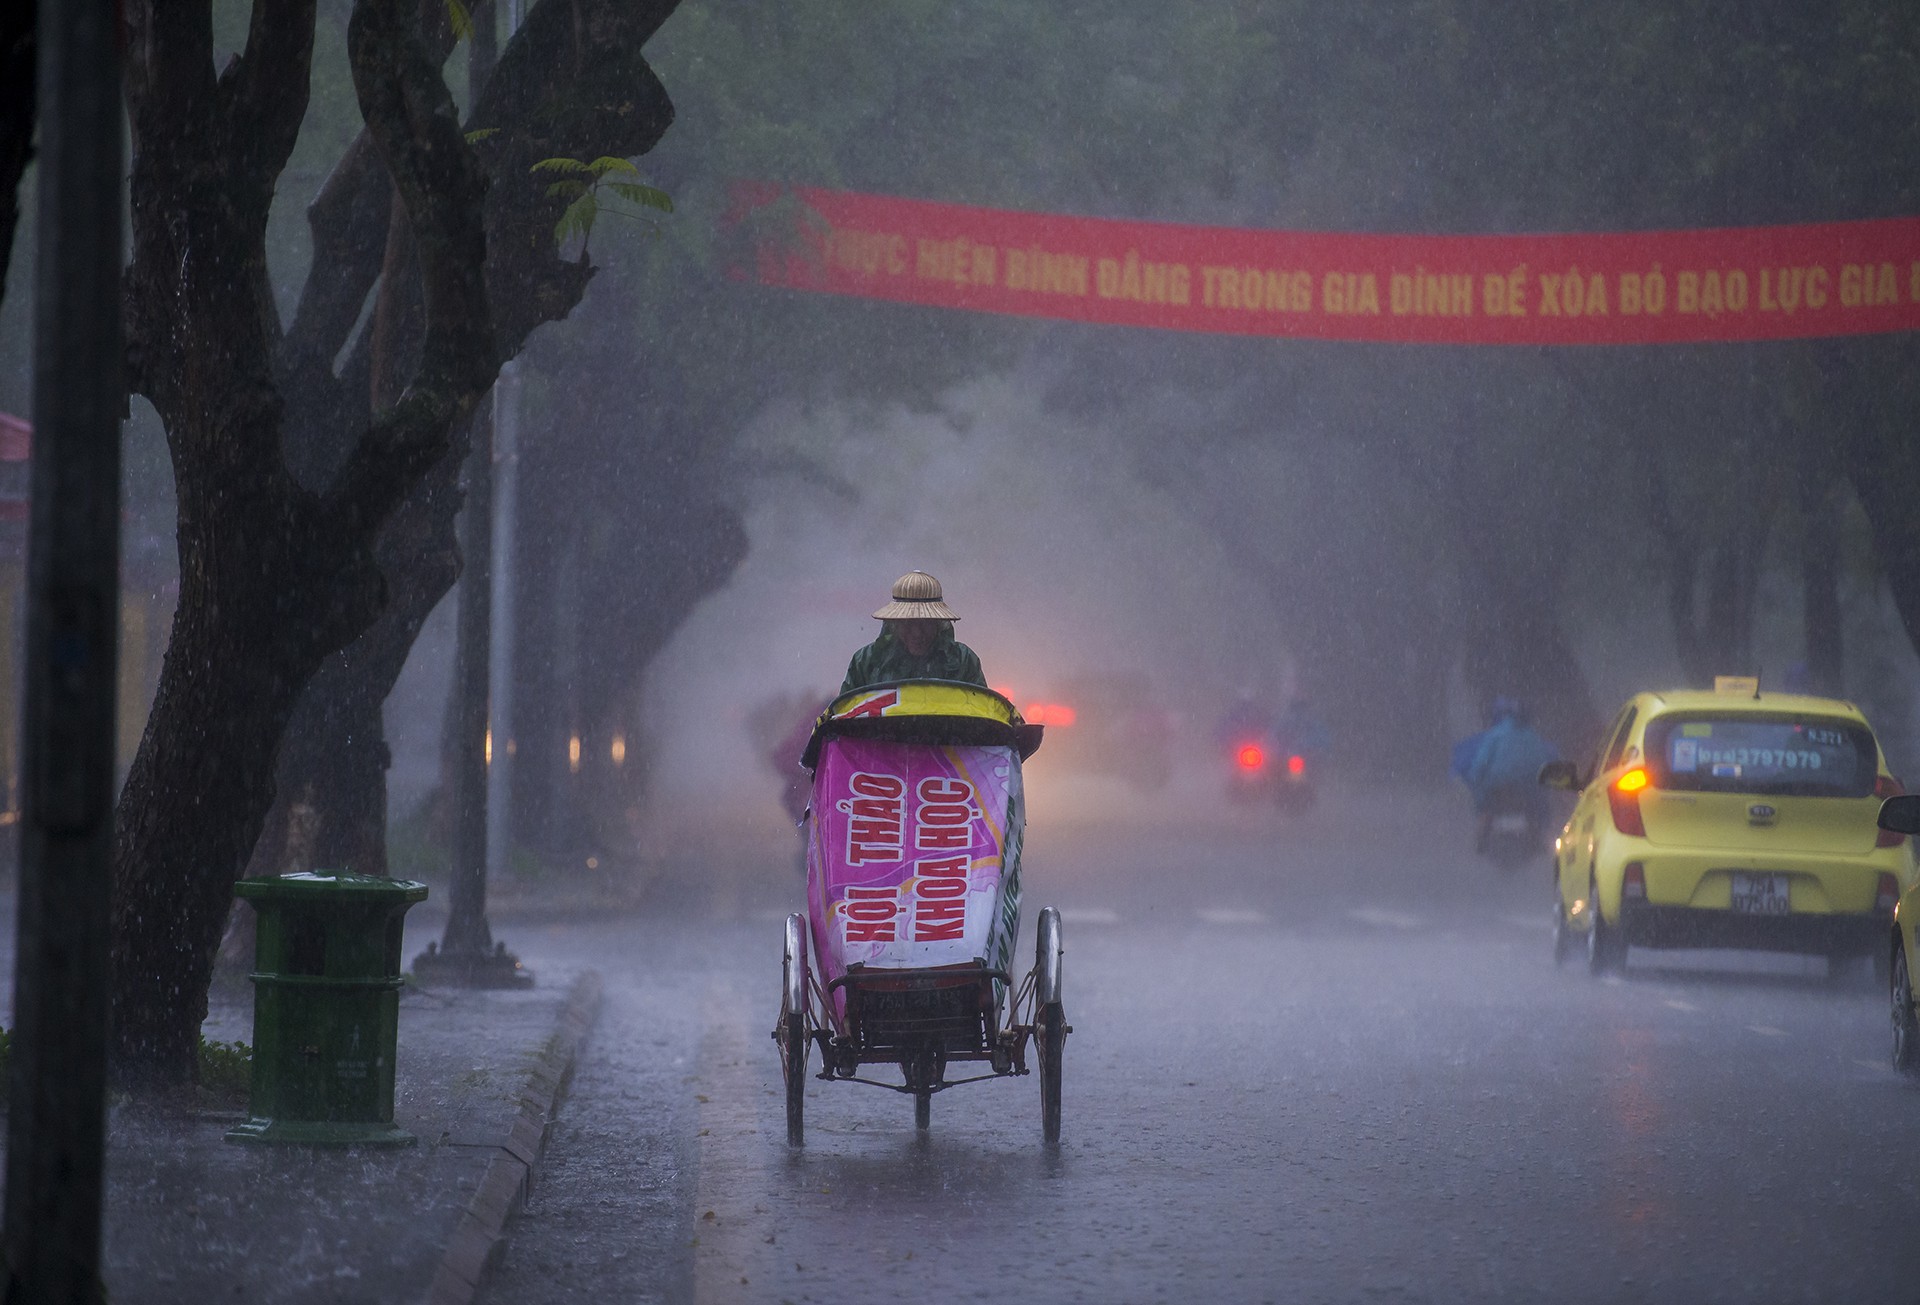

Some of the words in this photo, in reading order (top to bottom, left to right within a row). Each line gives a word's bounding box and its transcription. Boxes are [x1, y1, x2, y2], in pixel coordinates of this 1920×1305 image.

[1200, 265, 1313, 312] TRONG
[1322, 270, 1380, 316] GIA
[1390, 265, 1473, 317] ĐÌNH
[1538, 262, 1609, 318] XÓA
[1619, 260, 1667, 316] BỎ
[1678, 267, 1749, 320] BẠO
[1758, 264, 1828, 316] LỰC
[1839, 260, 1899, 308] GIA
[838, 772, 905, 866] THẢO
[917, 777, 982, 849] HỌC
[837, 887, 908, 942] HỘI
[914, 855, 970, 943] KHOA
